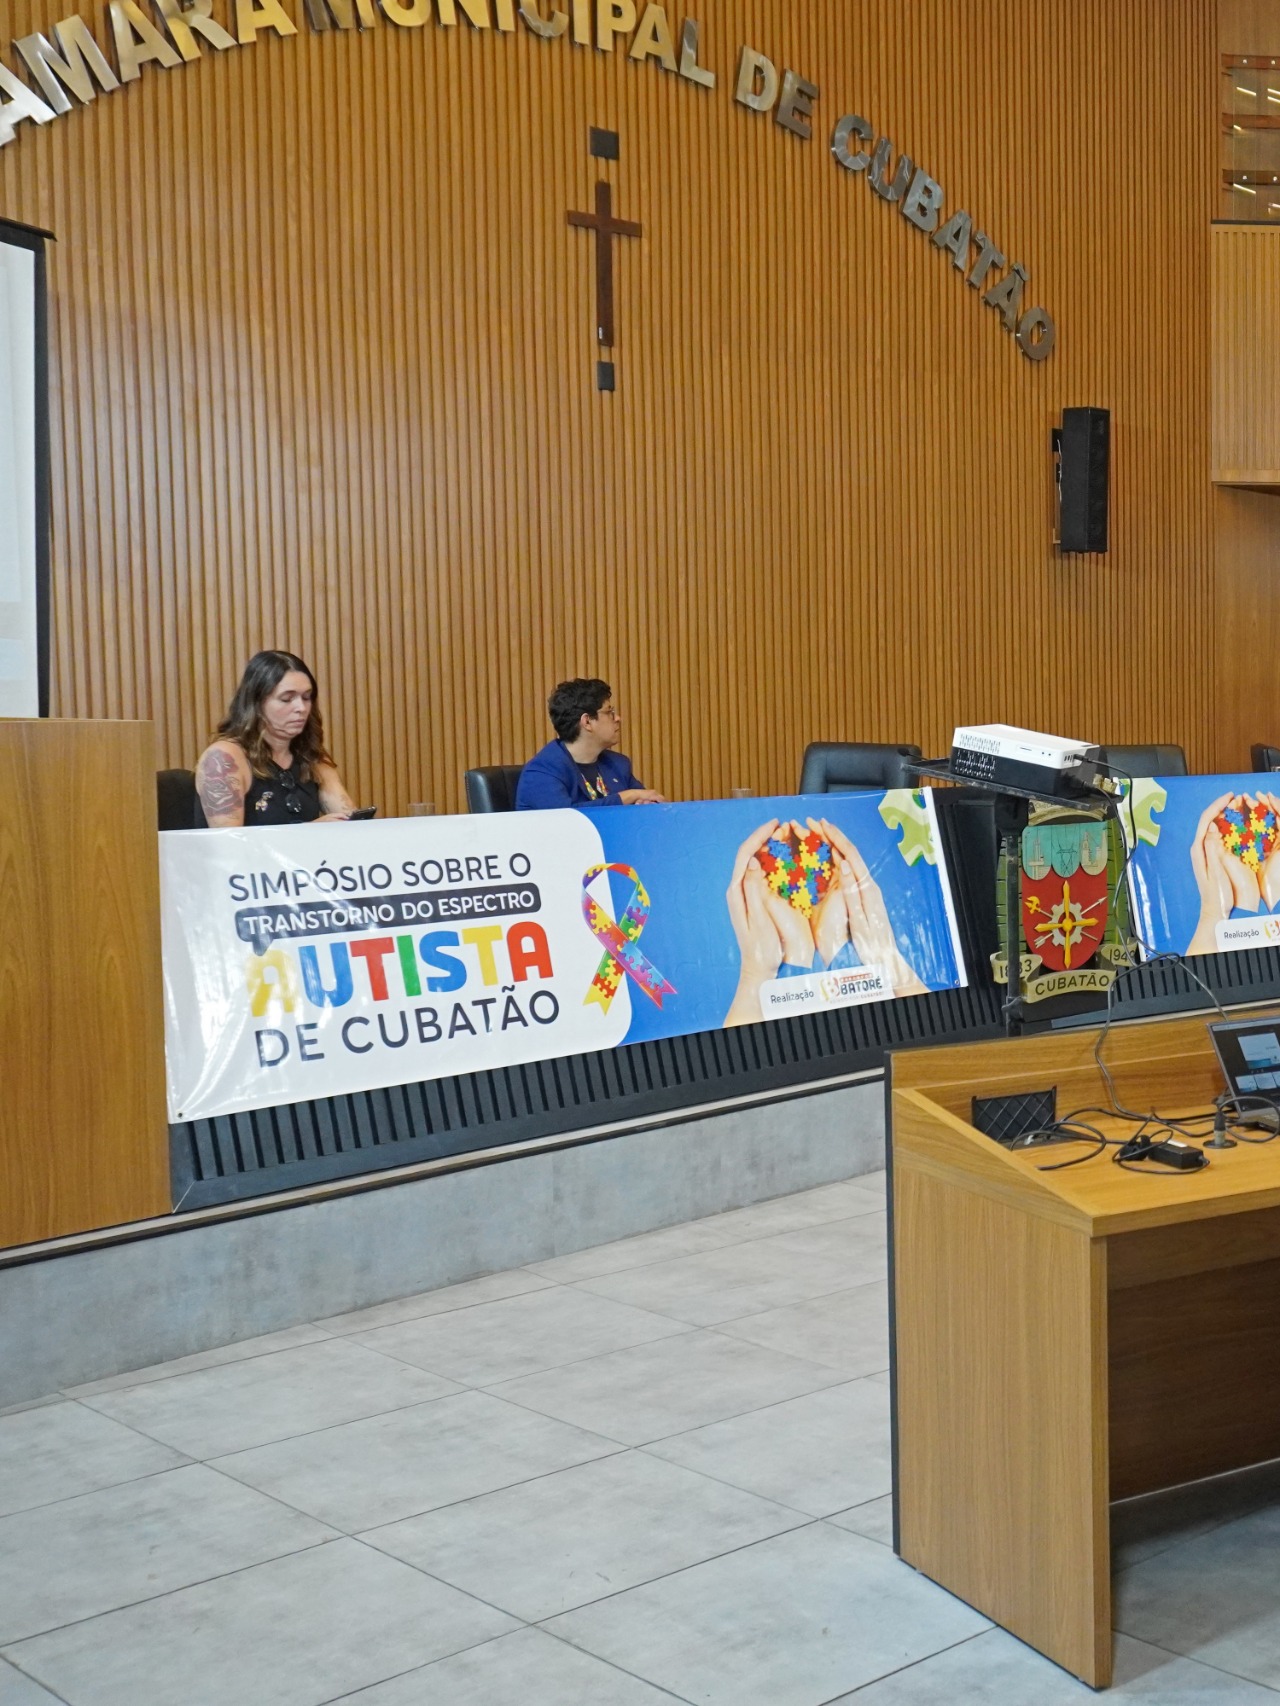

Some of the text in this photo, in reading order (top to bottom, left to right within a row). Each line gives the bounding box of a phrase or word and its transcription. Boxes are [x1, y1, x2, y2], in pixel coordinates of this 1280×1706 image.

[733, 45, 820, 140] DE
[831, 114, 1056, 361] CUBATÃO
[228, 852, 531, 901] SIMPÓSIO SOBRE O
[243, 890, 535, 935] TRANSTORNO DO ESPECTRO
[1223, 928, 1260, 939] Realização
[246, 921, 554, 1018] AUTISTA
[840, 976, 883, 995] BATORÉ
[1035, 972, 1110, 995] CUBATÃO
[770, 989, 815, 1004] Realização
[254, 984, 560, 1068] DE CUBATÃO
